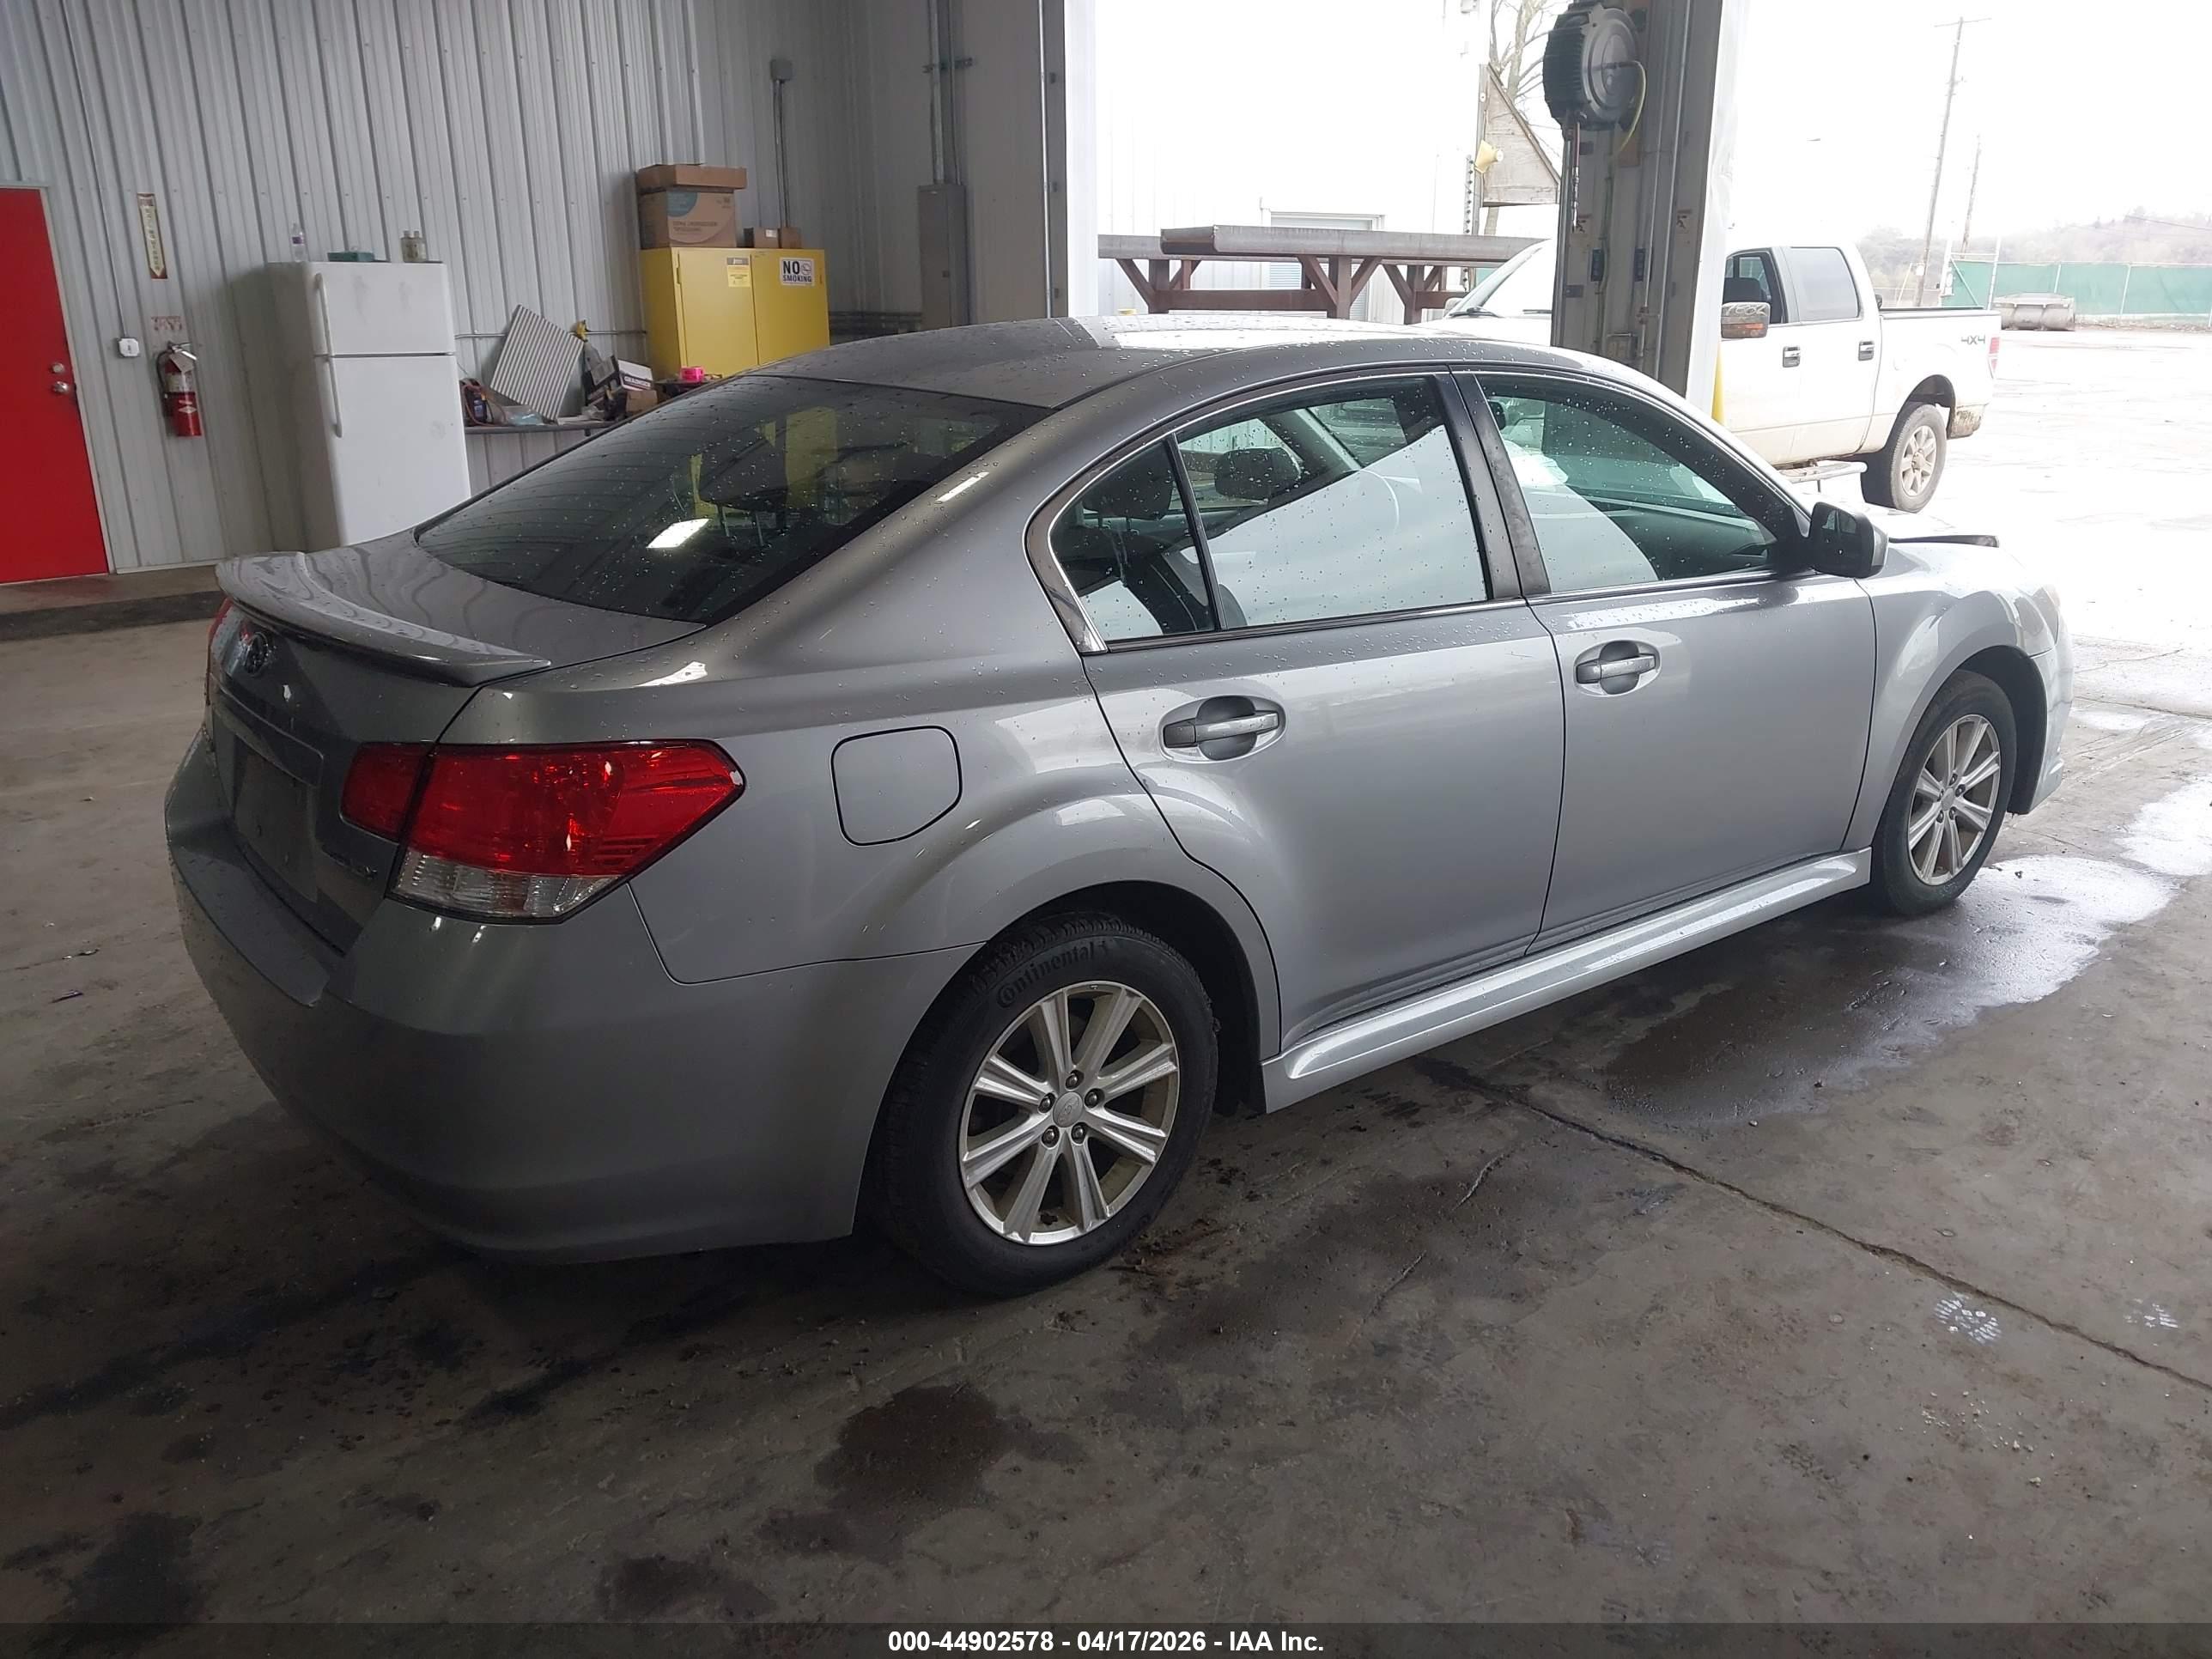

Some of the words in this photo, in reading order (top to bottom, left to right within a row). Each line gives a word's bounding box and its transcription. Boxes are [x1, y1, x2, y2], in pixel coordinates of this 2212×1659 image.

[782, 260, 800, 274] NO
[782, 274, 812, 283] SMOKING
[996, 940, 1095, 1008] Continental
